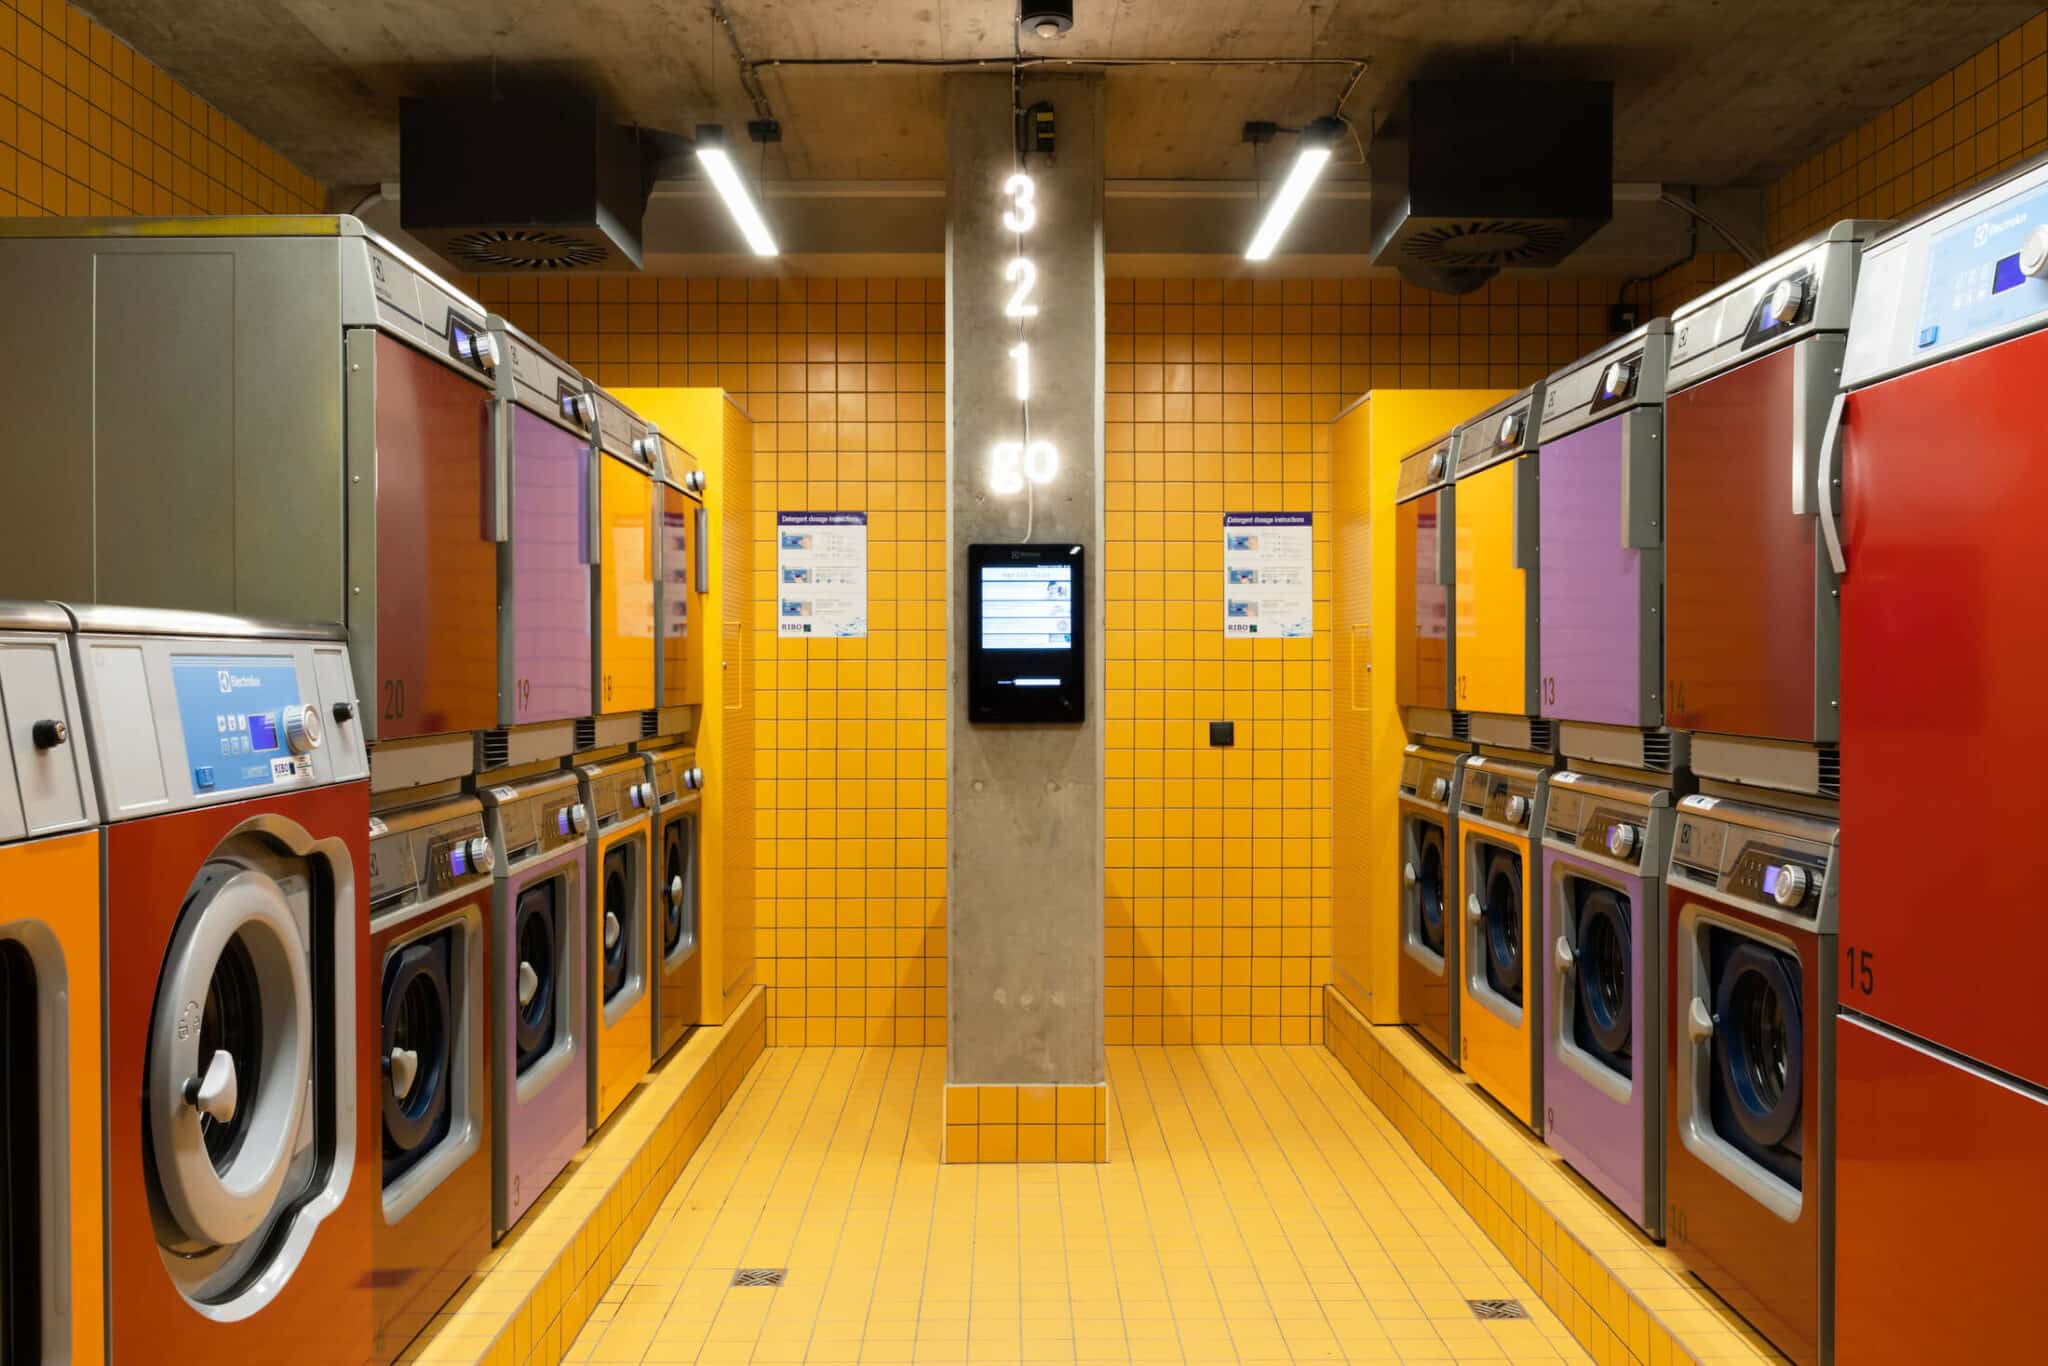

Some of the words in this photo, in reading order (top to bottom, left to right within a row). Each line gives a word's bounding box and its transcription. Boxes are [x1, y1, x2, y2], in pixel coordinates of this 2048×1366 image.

[1003, 174, 1037, 233] 3
[1005, 257, 1038, 317] 2
[1009, 342, 1030, 401] 1
[782, 515, 807, 524] Detergent
[808, 515, 829, 524] dosage
[1227, 516, 1253, 525] Detergent
[1254, 516, 1274, 525] dosage
[384, 680, 404, 720] 20
[517, 679, 529, 712] 19
[1457, 675, 1467, 700] 12
[1543, 677, 1555, 706] 13
[1846, 947, 1874, 995] 15
[1547, 1107, 1554, 1135] 9
[513, 1175, 521, 1207] 3
